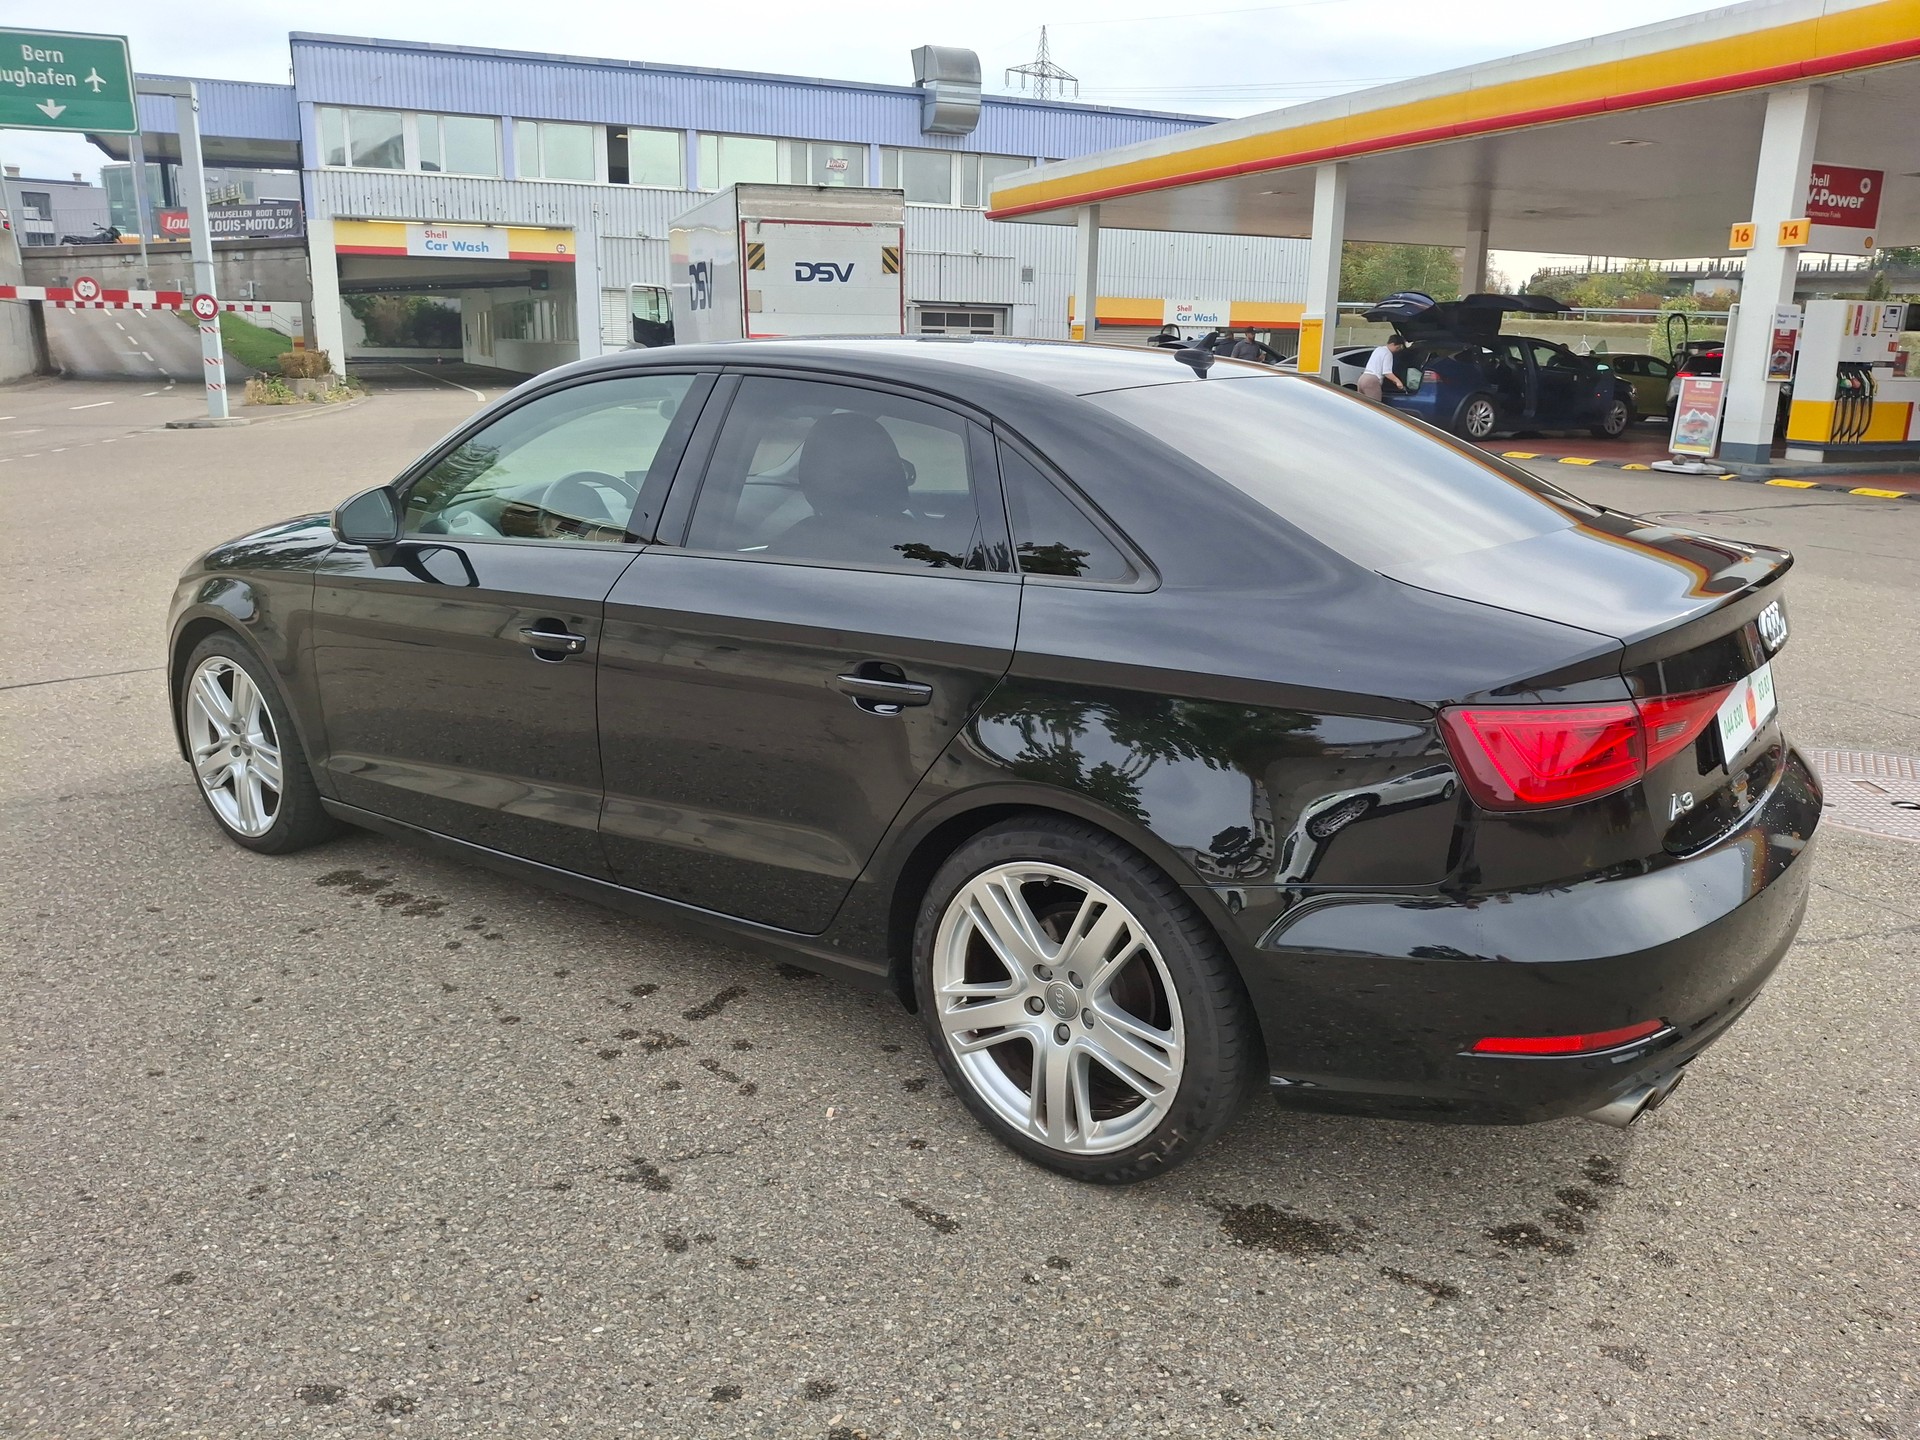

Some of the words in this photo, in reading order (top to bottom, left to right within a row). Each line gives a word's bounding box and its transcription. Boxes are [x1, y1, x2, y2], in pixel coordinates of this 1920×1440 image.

[21, 44, 64, 63] Bern
[1806, 188, 1865, 209] V-Power
[255, 209, 273, 217] ROOT
[276, 208, 293, 217] ETOY
[166, 216, 190, 230] Lou
[209, 218, 293, 232] LOUIS-MOTO.CH
[424, 230, 447, 239] Shell
[1734, 228, 1749, 243] 16
[1782, 225, 1799, 240] 14
[425, 240, 448, 251] Car
[452, 241, 489, 253] Wash
[795, 262, 855, 283] DSV
[689, 258, 713, 311] DSV
[1176, 313, 1191, 322] Car
[1194, 313, 1218, 322] Wash
[1668, 791, 1695, 822] A3
